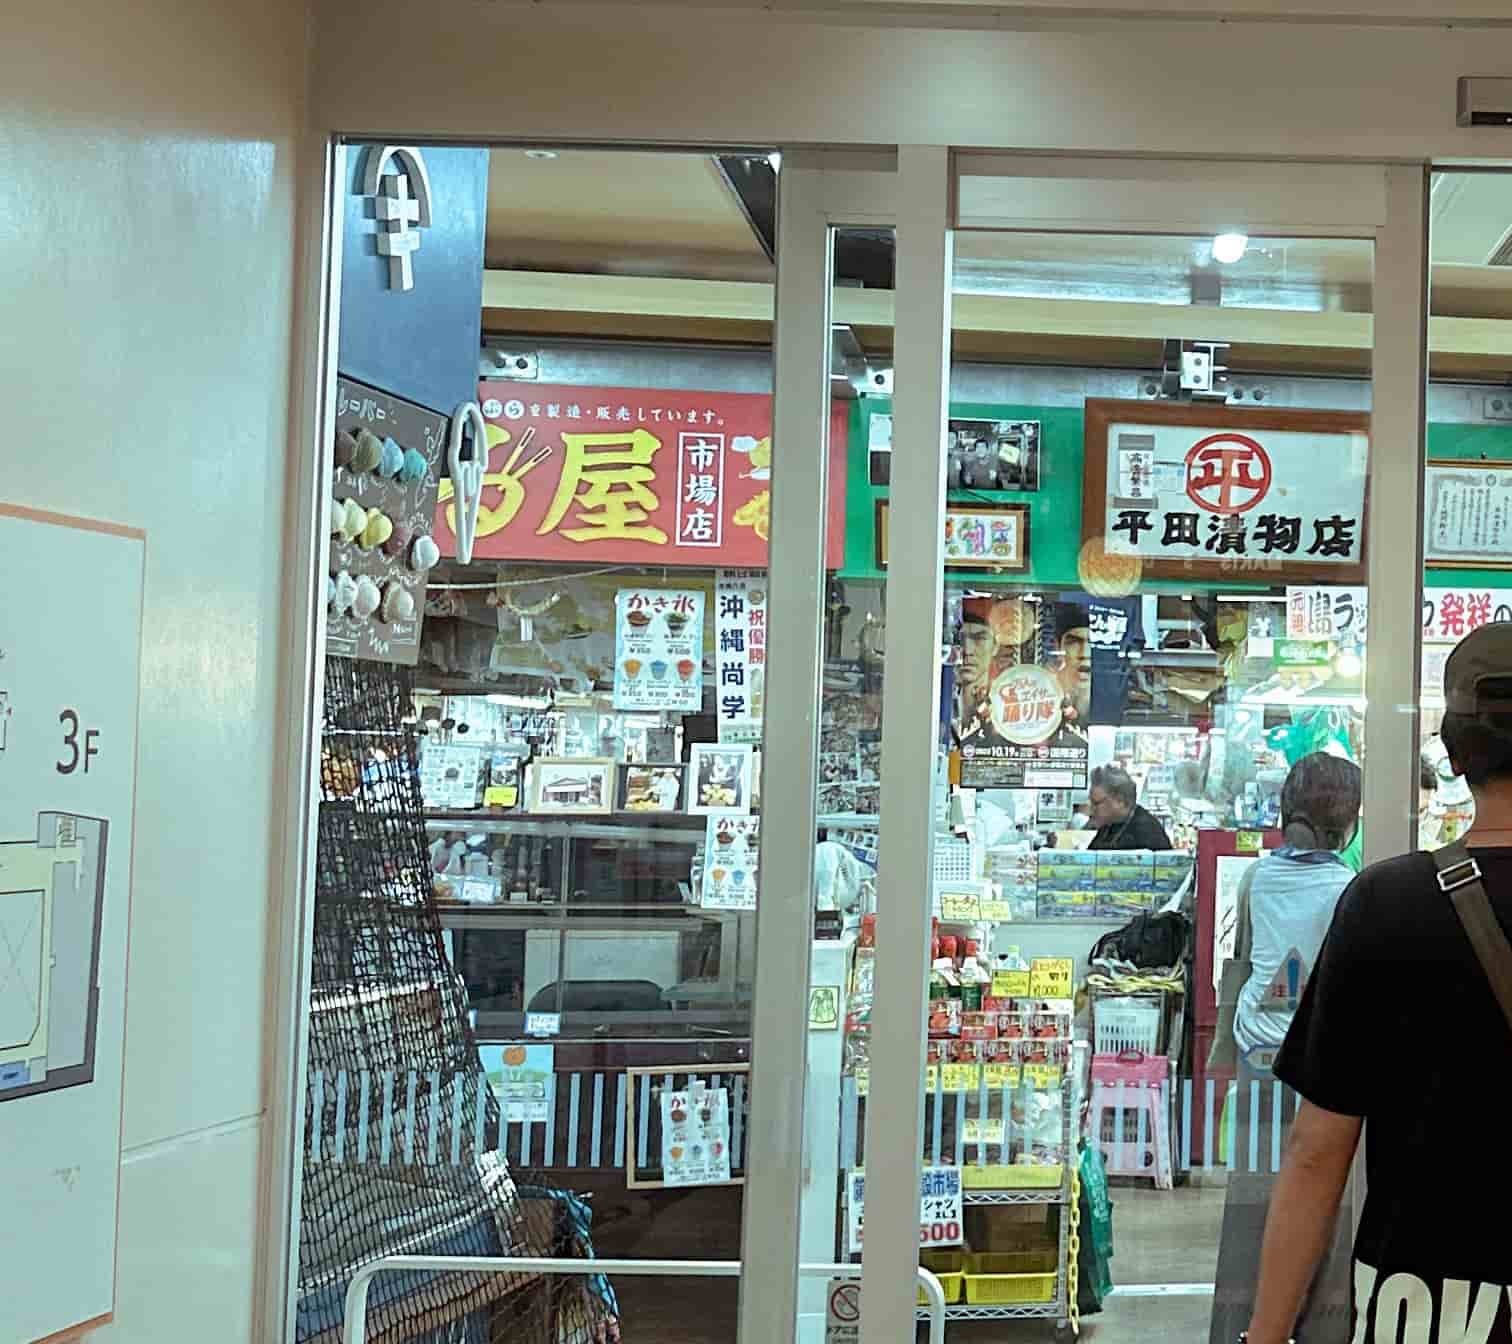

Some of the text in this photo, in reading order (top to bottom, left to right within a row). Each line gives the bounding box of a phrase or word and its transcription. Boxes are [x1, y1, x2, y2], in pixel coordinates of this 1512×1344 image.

[681, 437, 718, 541] 市場店
[1111, 510, 1356, 557] 平田漬物店
[627, 592, 696, 614] かき氷
[719, 594, 745, 720] 沖縄尚学
[56, 708, 99, 775] 3F
